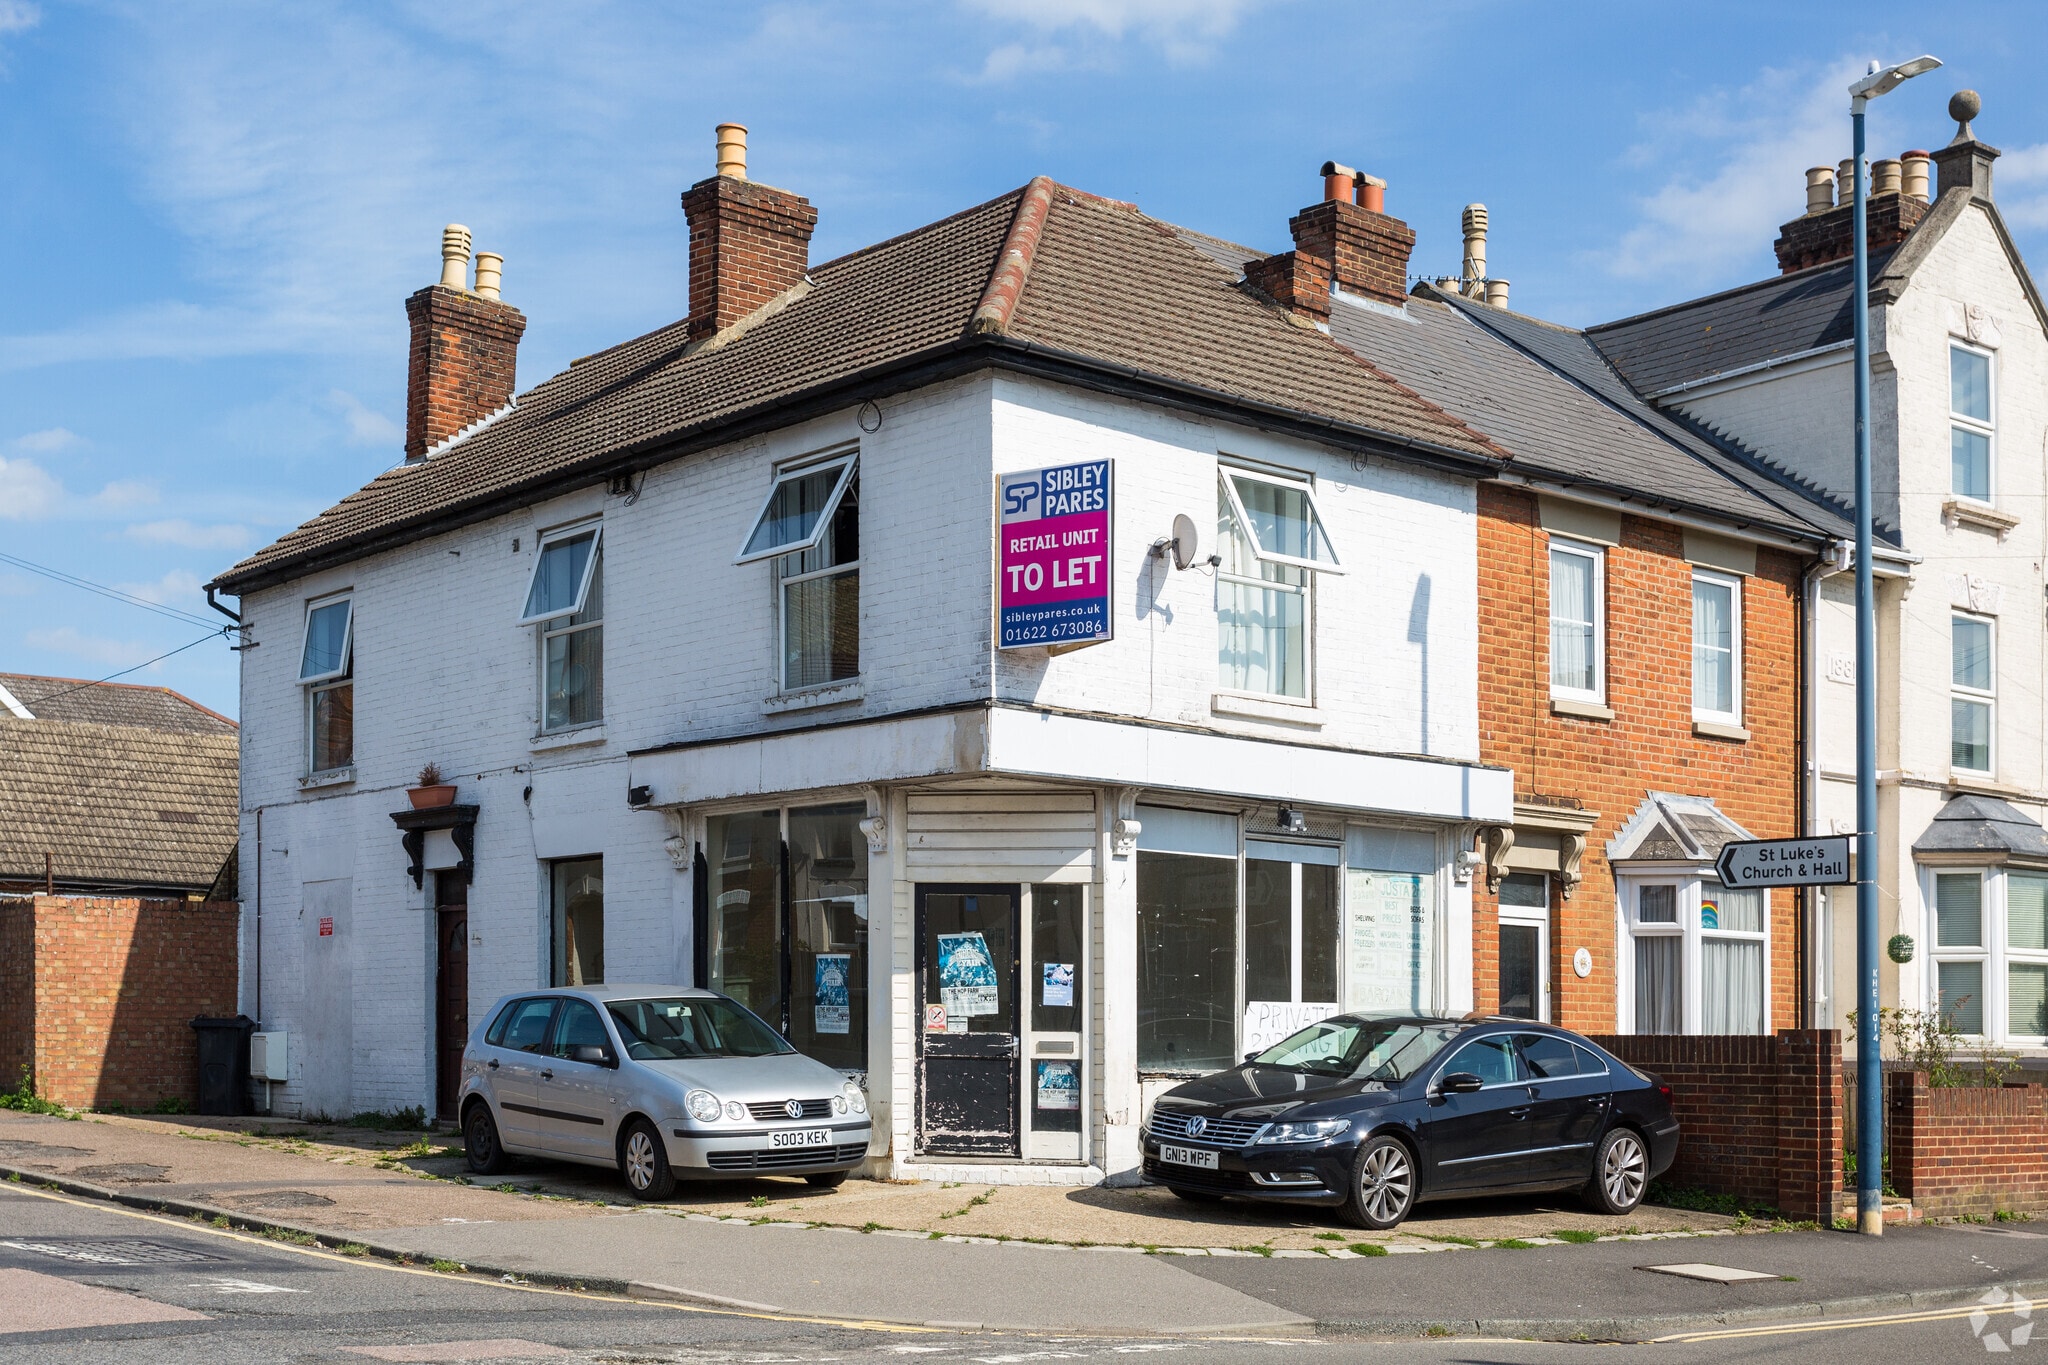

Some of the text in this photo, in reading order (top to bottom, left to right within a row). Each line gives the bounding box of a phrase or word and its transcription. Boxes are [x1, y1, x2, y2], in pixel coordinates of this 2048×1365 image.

[1045, 463, 1106, 492] SIBLEY
[1045, 488, 1105, 516] PARES
[1010, 528, 1099, 553] RETAIL UNIT
[1007, 555, 1102, 593] TO LET
[1006, 603, 1100, 623] sibleypares.co.uk
[1006, 619, 1102, 641] 01622 673086
[1758, 845, 1825, 862] St Luke's
[1742, 861, 1842, 880] Church & Hall
[807, 1130, 828, 1145] KEK
[1165, 1147, 1211, 1167] GN13 WPF
